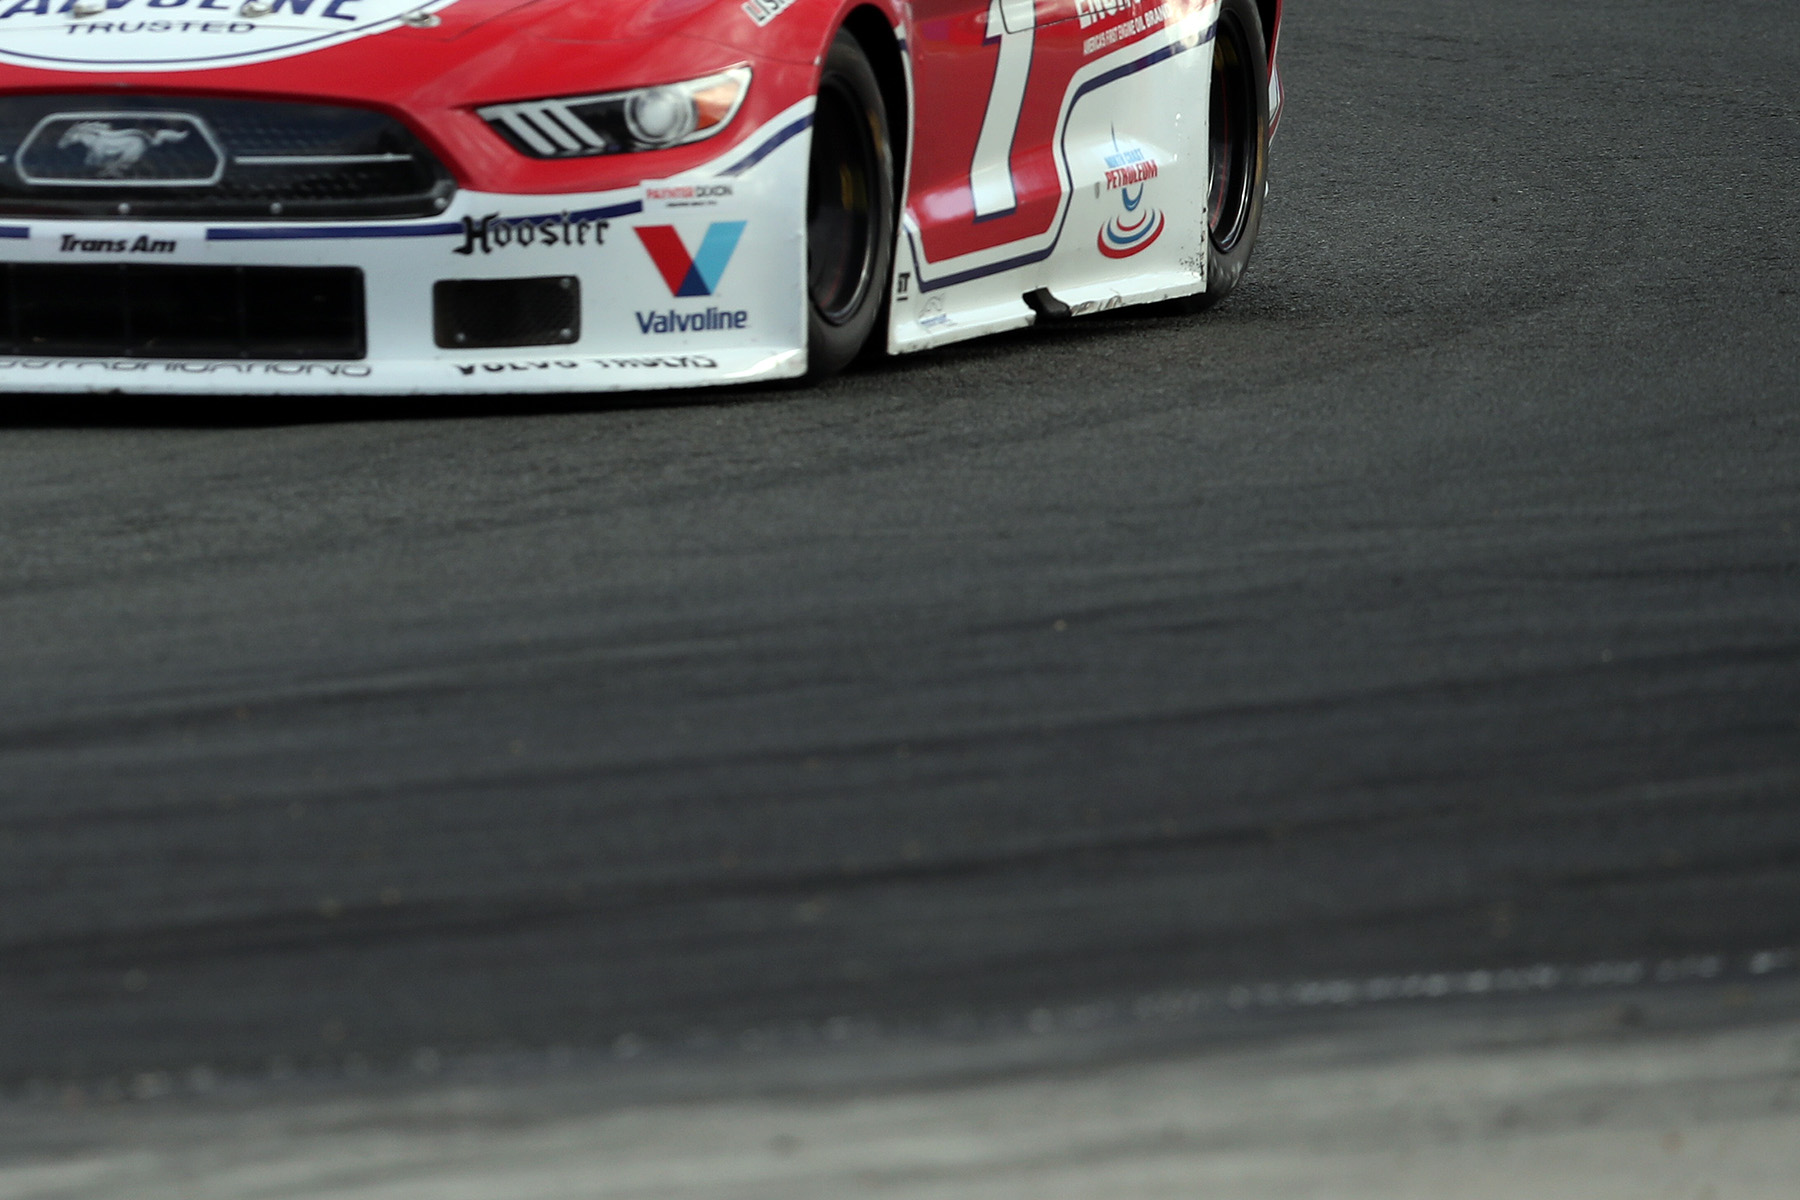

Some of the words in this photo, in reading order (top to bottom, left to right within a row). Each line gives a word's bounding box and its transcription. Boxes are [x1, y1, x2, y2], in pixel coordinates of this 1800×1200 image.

[66, 19, 257, 36] TRUSTED
[60, 234, 128, 252] Trans
[128, 234, 178, 252] Am
[452, 209, 610, 255] Hoosier
[635, 306, 749, 335] Valvoline
